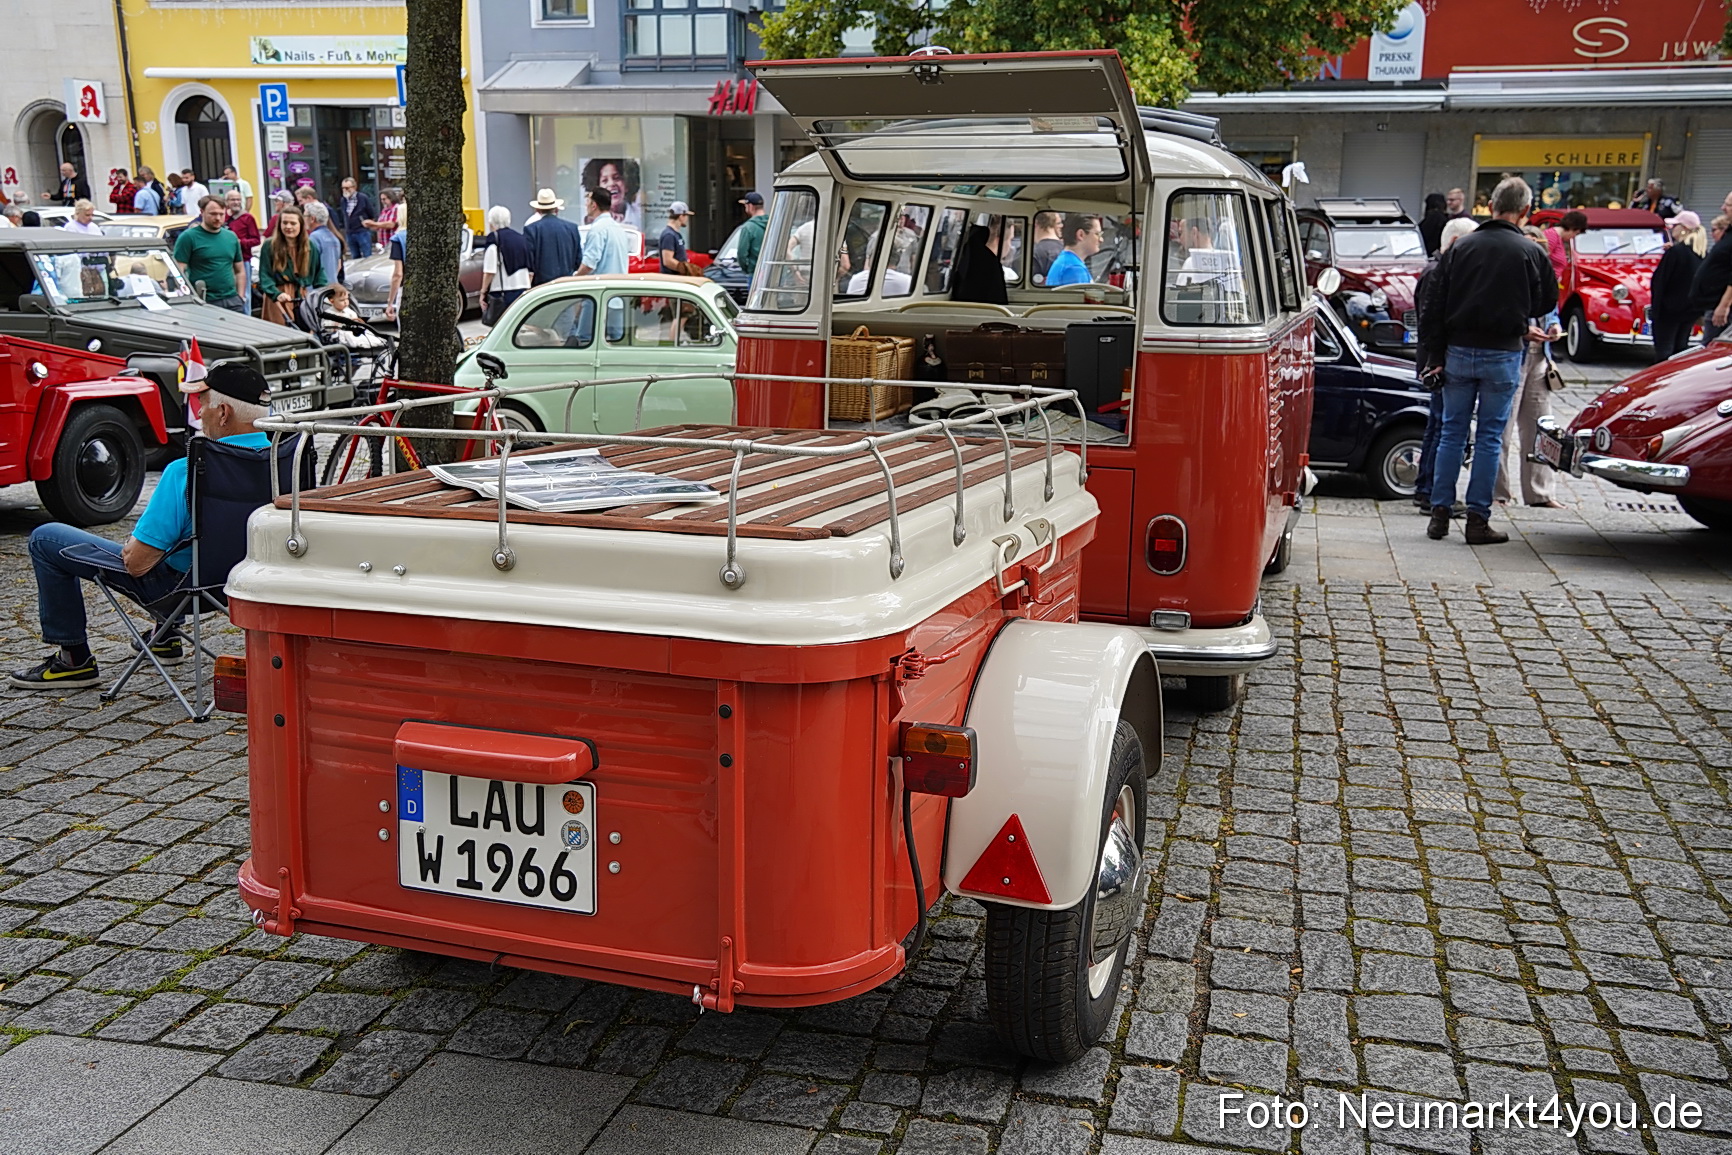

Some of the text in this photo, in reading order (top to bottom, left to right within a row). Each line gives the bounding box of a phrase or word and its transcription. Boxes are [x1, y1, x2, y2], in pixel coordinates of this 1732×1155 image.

[284, 51, 316, 62] Nails
[327, 51, 352, 62] Fuß
[355, 53, 363, 62] &
[366, 51, 399, 62] Mehr
[1379, 52, 1413, 62] PRESSE
[1375, 66, 1416, 76] THUMANN
[265, 88, 282, 119] P
[707, 79, 758, 117] H&M
[142, 121, 157, 135] 39
[1543, 152, 1641, 165] SCHLIERF
[292, 395, 313, 410] 513H
[407, 799, 417, 815] D
[450, 775, 546, 837] LAU
[416, 831, 578, 902] W 1966
